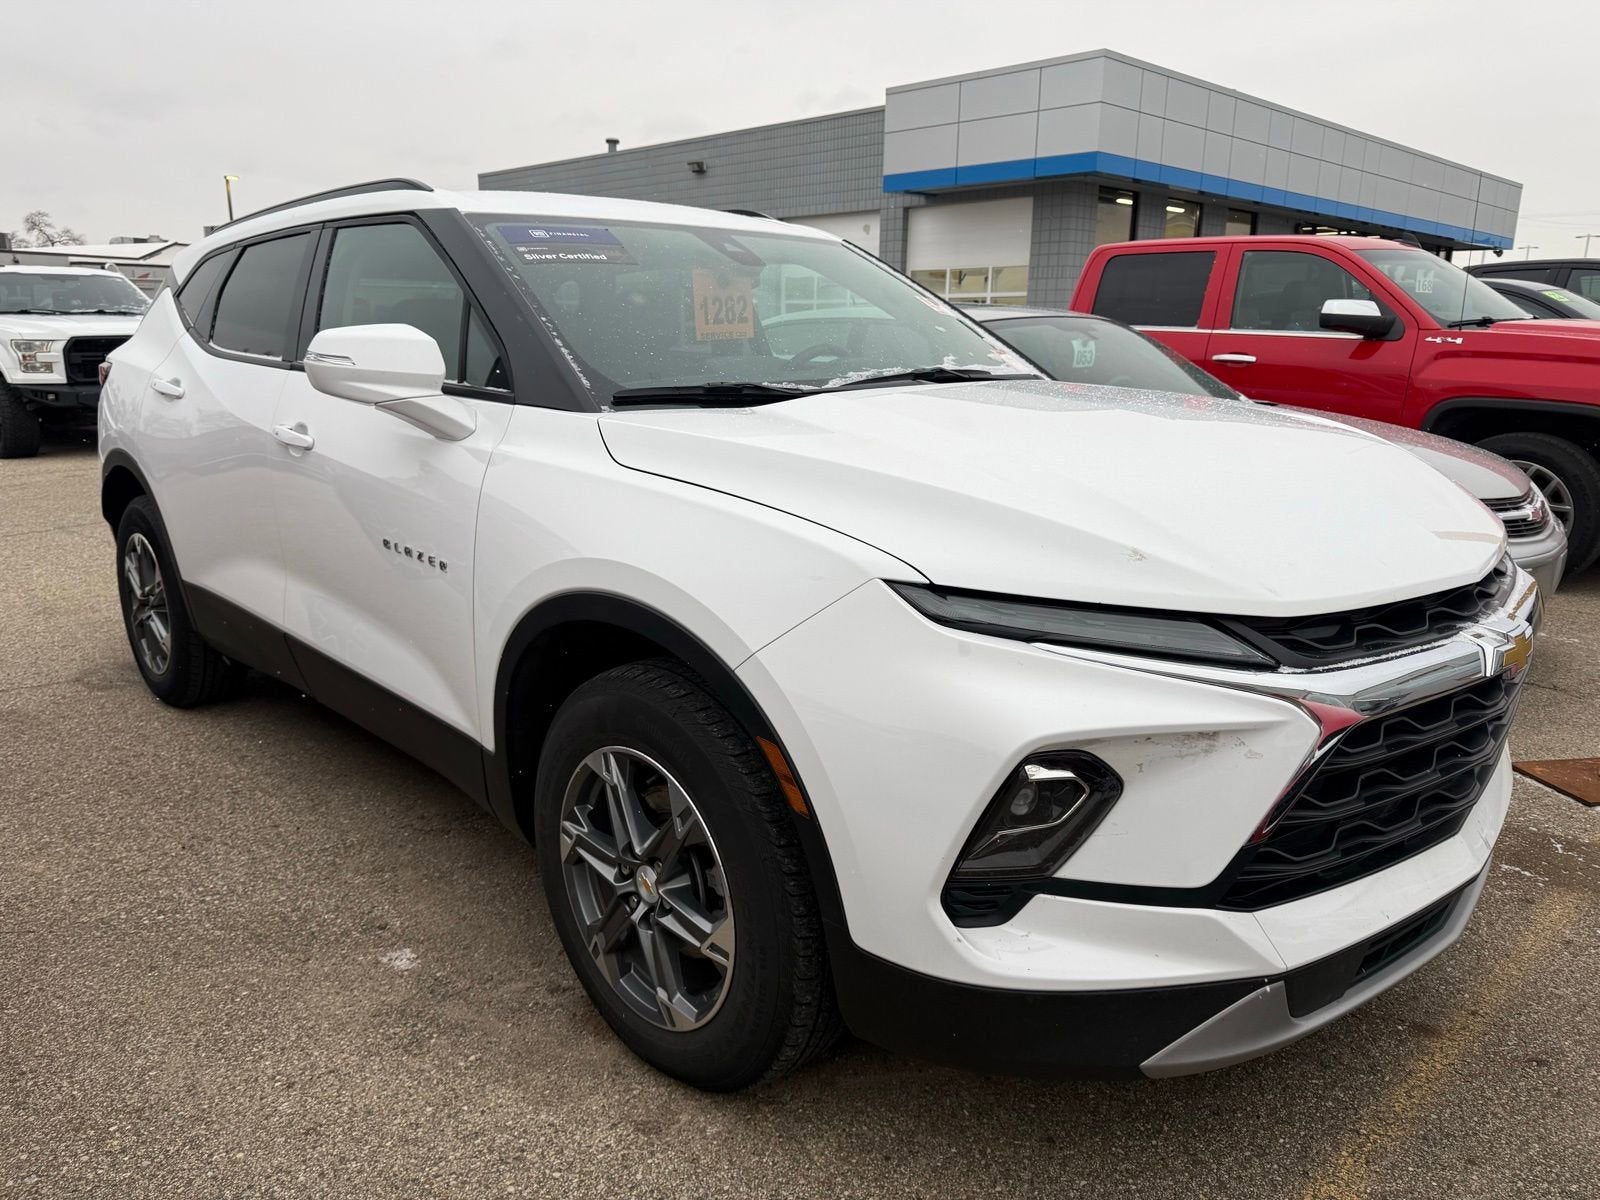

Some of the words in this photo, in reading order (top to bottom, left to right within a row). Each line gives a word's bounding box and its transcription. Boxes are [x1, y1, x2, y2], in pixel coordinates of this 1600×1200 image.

[558, 252, 608, 260] Certified
[1417, 279, 1433, 292] 168
[382, 538, 448, 574] BLAZER
